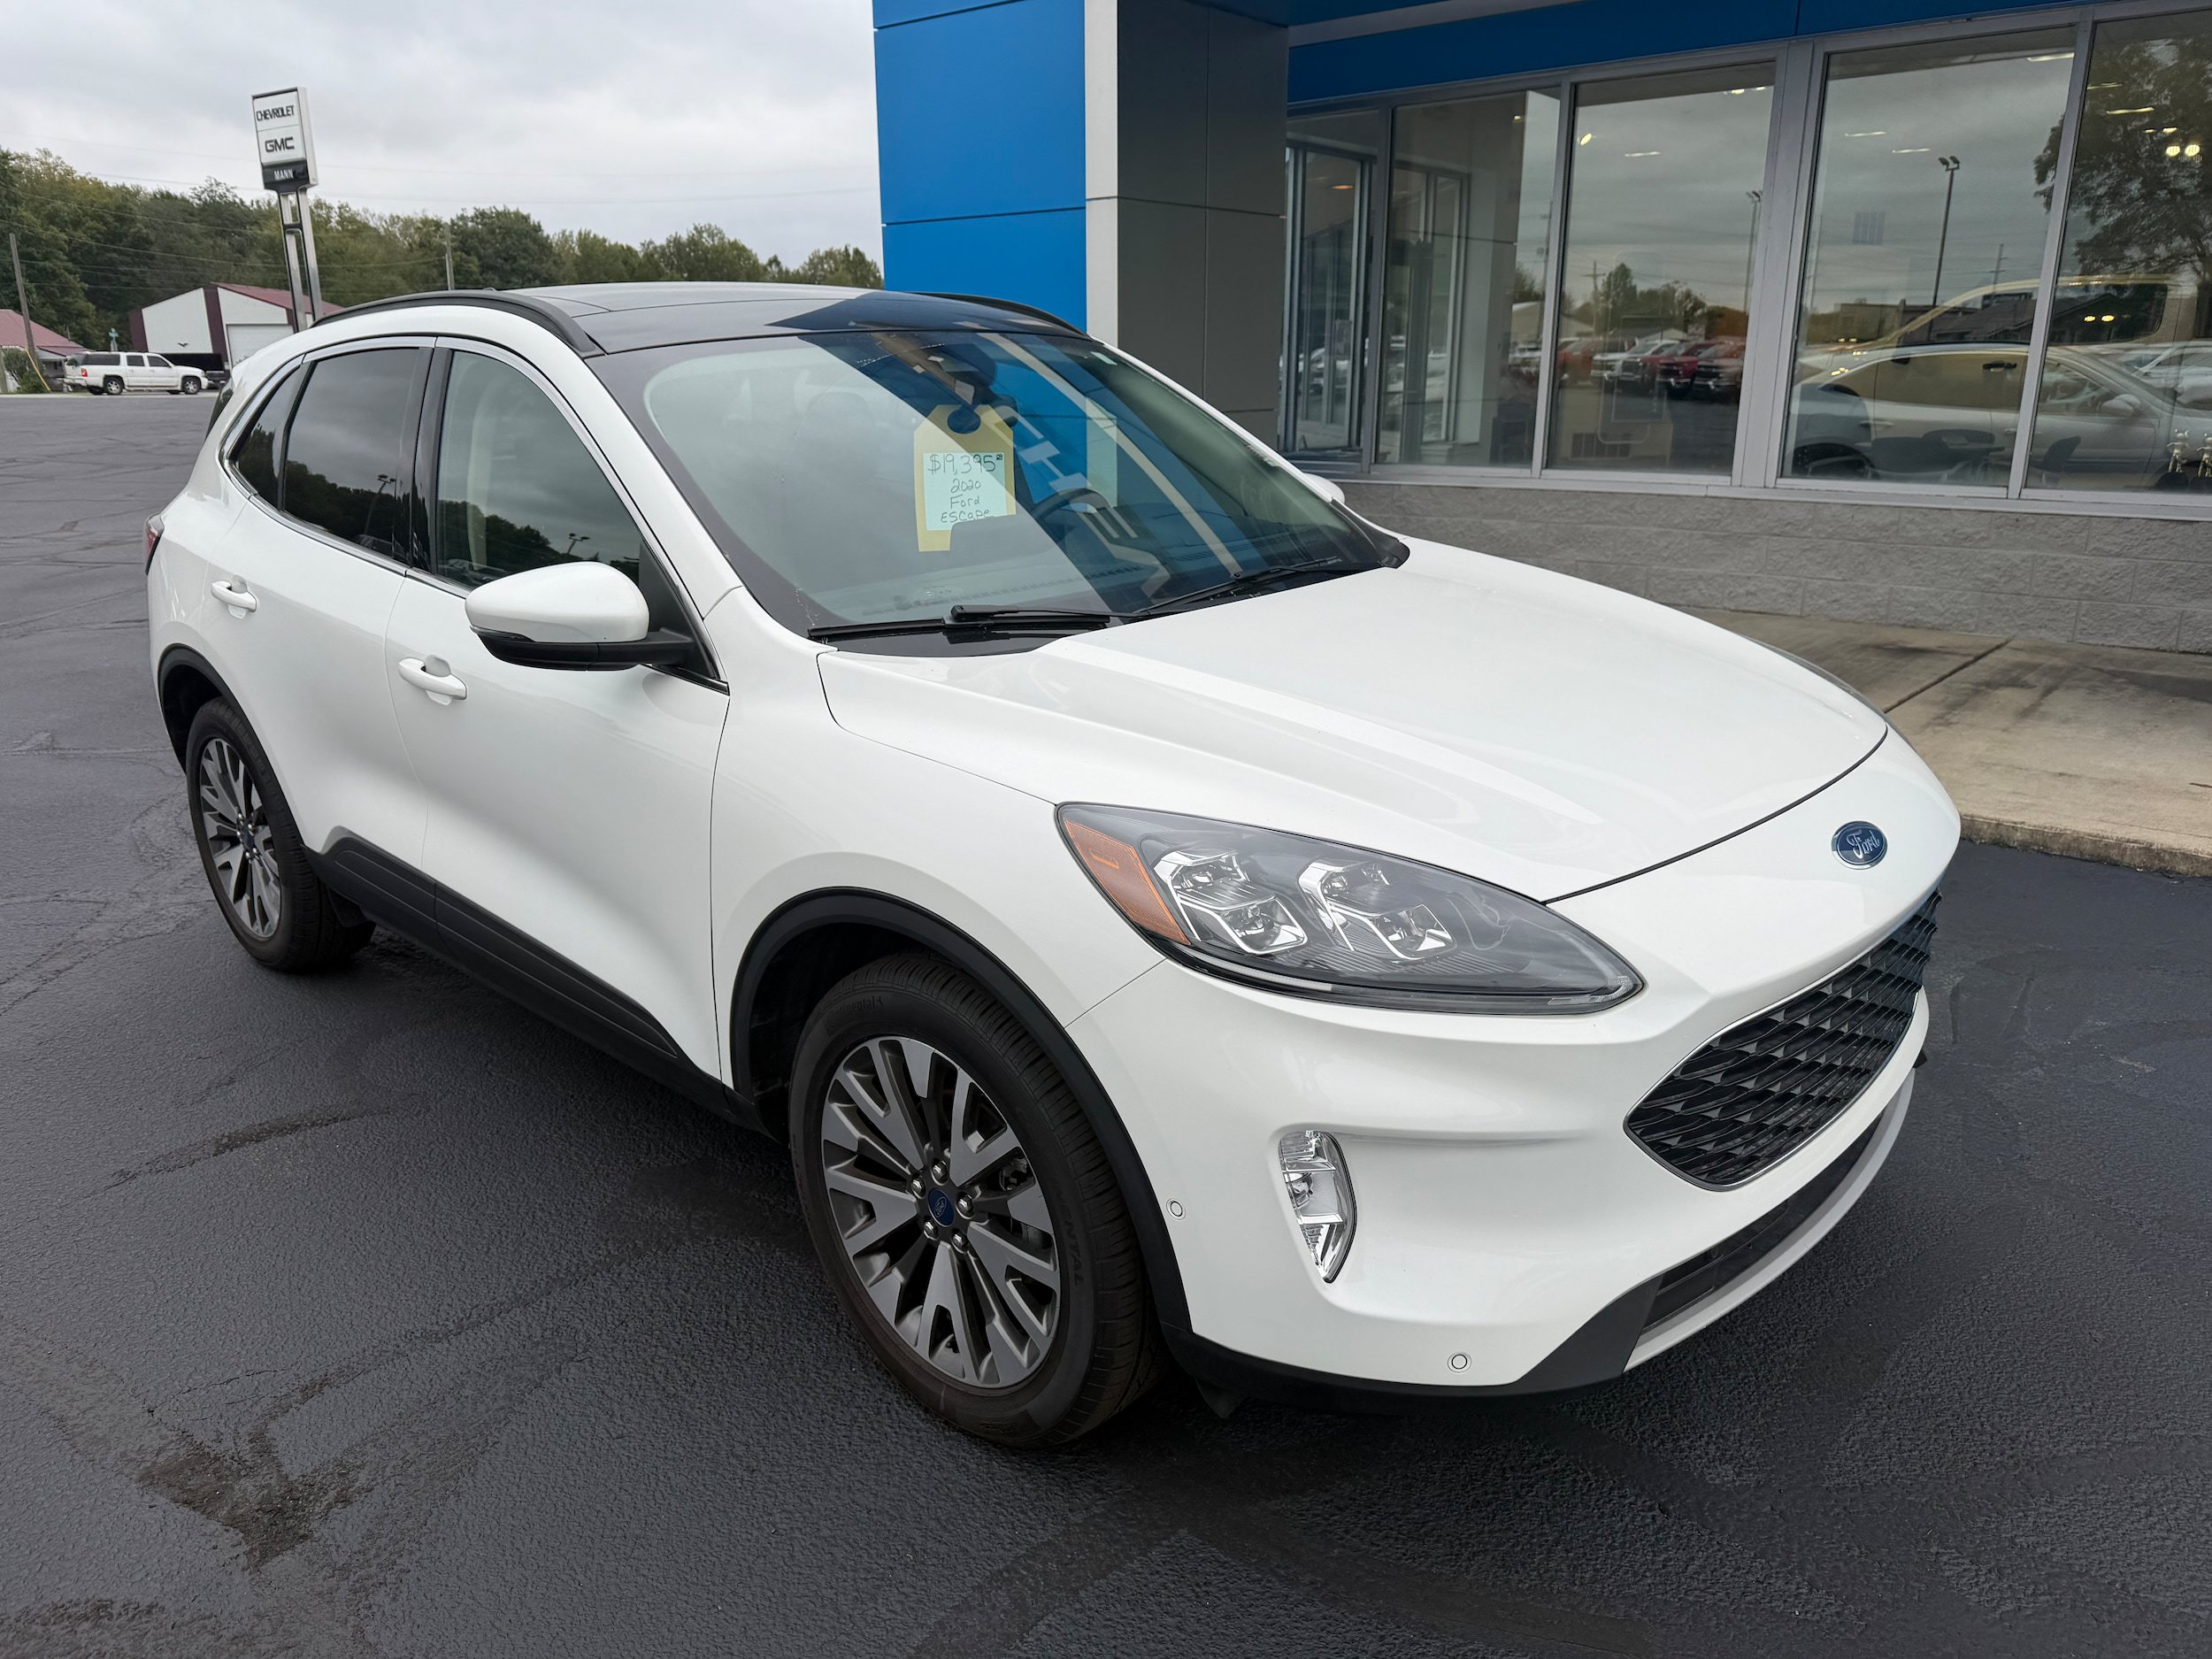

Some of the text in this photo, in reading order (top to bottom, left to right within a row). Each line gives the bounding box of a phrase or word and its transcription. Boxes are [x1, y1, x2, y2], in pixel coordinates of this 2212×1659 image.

[256, 105, 295, 121] CHEVROLET
[265, 136, 295, 153] GMC
[273, 168, 295, 180] MANN
[950, 478, 981, 494] 2020
[949, 494, 980, 509] Ford
[1845, 828, 1880, 859] Ford
